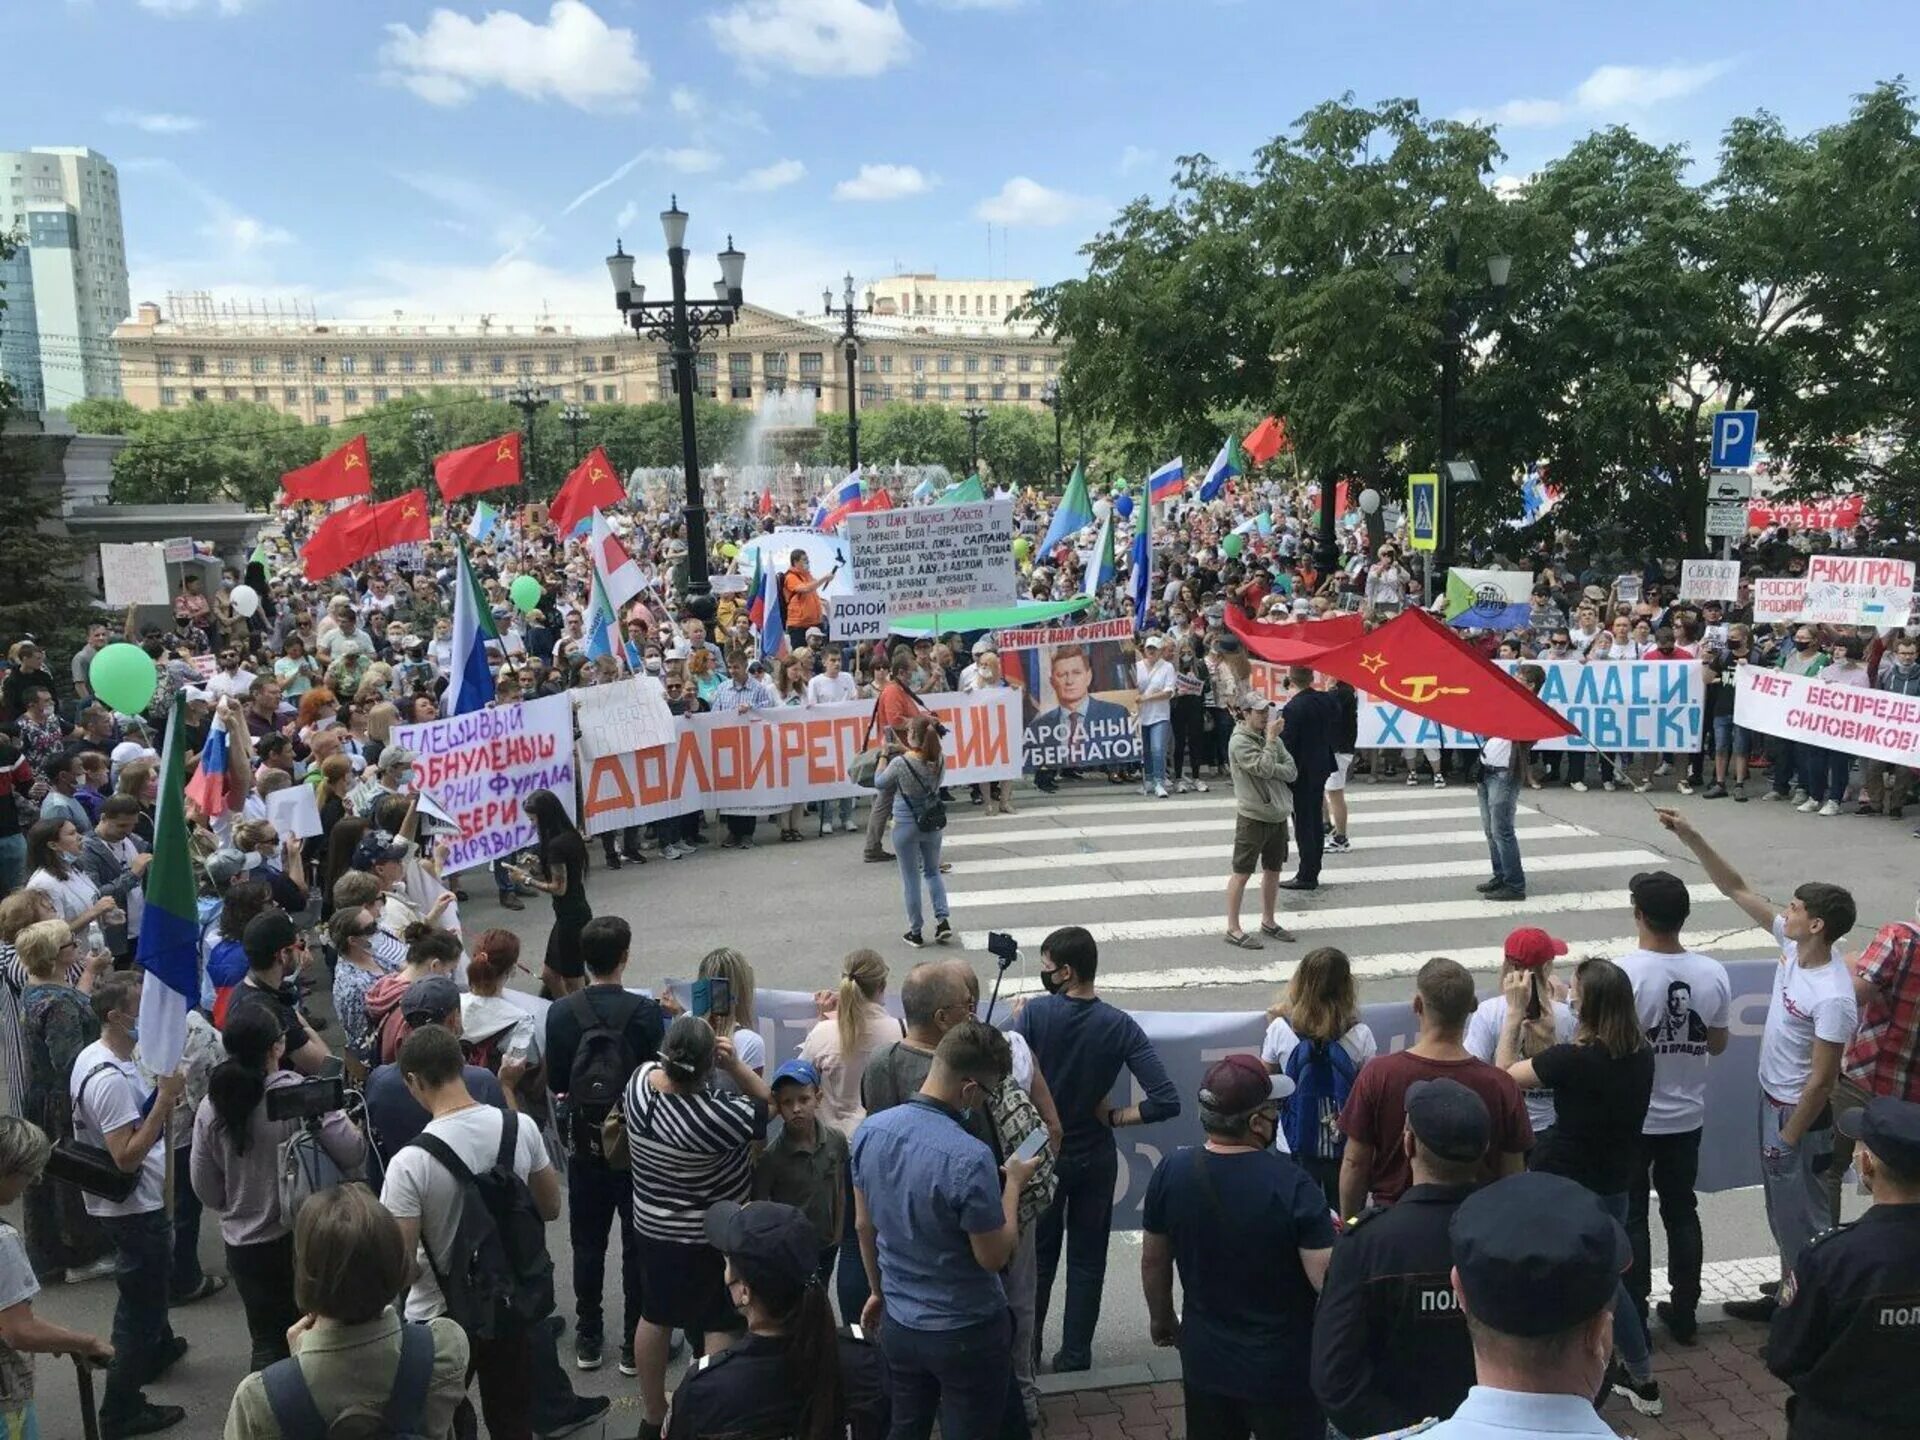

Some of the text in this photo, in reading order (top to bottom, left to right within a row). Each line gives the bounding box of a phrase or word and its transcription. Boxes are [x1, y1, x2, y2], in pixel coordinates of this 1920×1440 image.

[1811, 558, 1912, 587] РУКИ ПРОЧЬ
[1761, 580, 1807, 596] РОССИ
[834, 600, 886, 618] ДОЛОЙ
[841, 621, 880, 636] ЦАРЯ
[999, 619, 1132, 649] ЕРНИТЕ НАМ ФУРГАЛА
[1752, 674, 1792, 697] НЕТ
[401, 703, 525, 755] ПЛЕШИВЫЙ
[1022, 711, 1141, 745] АРОДНЫЙ
[1786, 709, 1919, 752] СИЛОВИКОВ!
[489, 764, 571, 796] ФУРГАЛА
